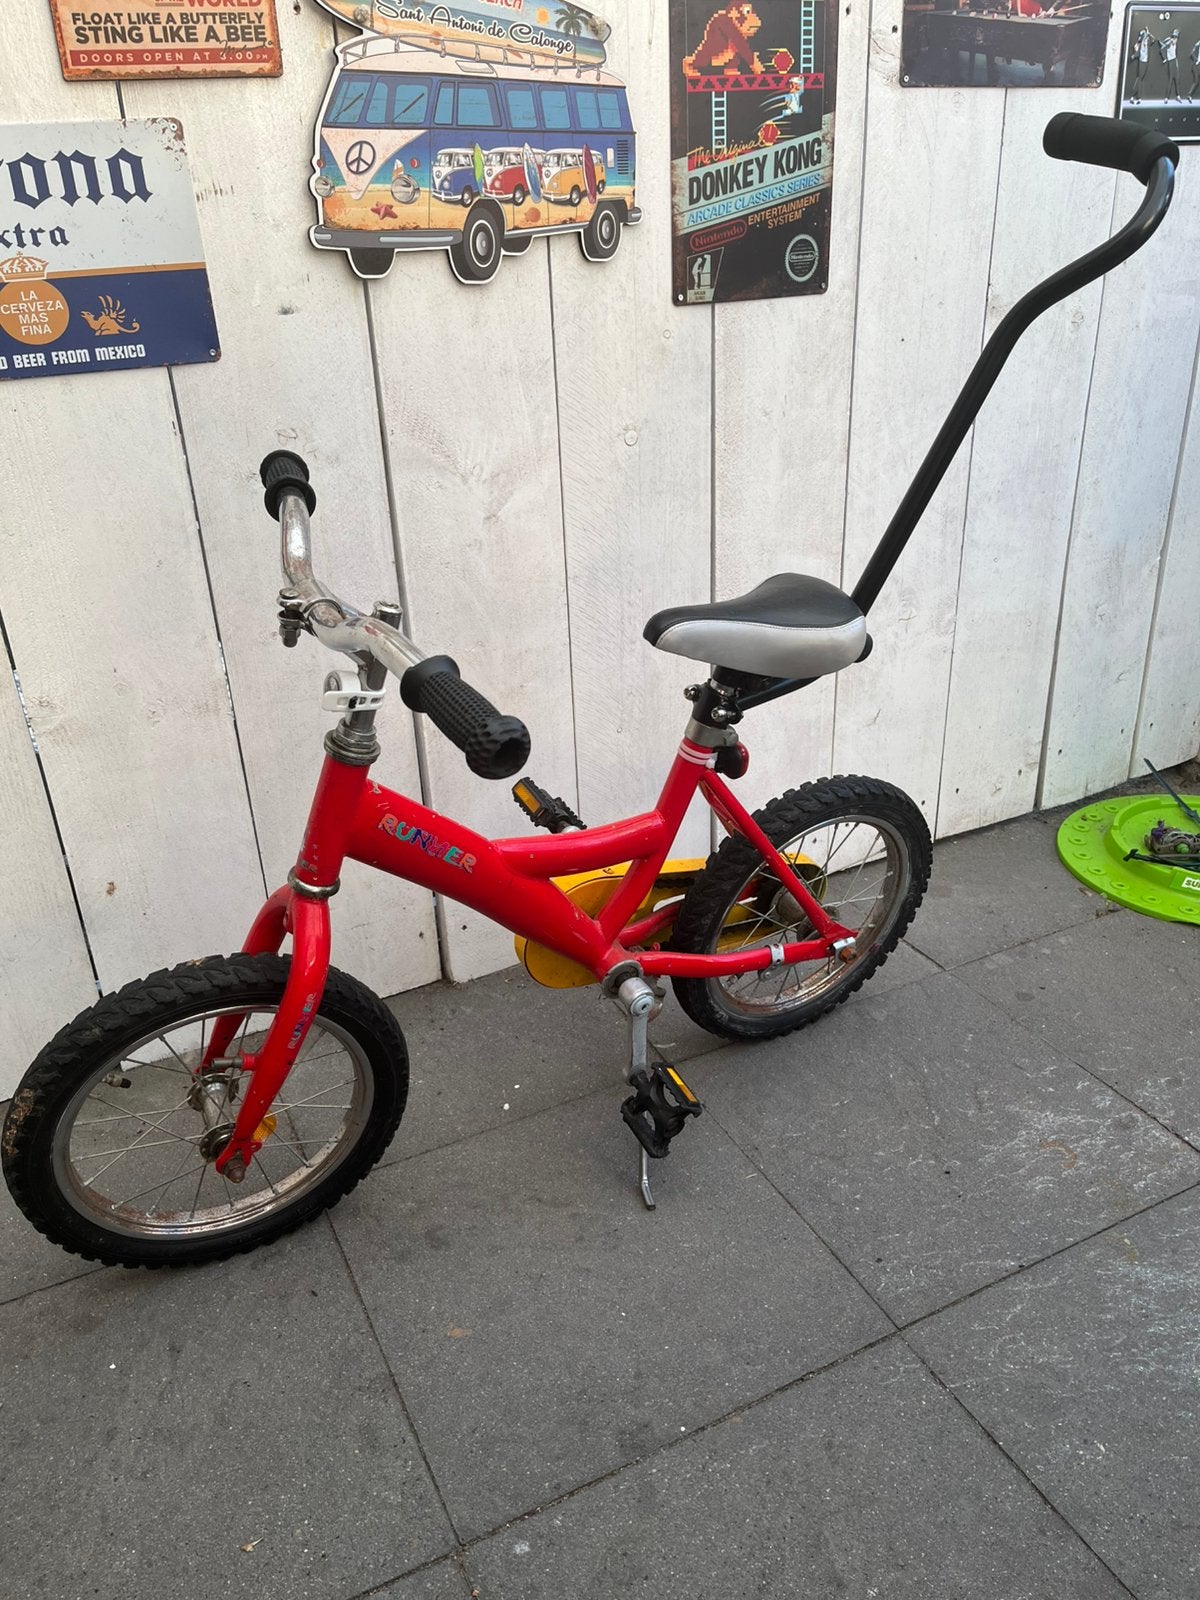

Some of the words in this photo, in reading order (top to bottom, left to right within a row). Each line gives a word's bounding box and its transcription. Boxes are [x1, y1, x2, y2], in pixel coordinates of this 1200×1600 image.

[72, 12, 123, 25] FLOAT
[127, 13, 161, 24] LIKE
[165, 12, 177, 25] A
[180, 12, 264, 24] BUTTERFLY
[376, 0, 423, 20] Sant
[428, 6, 485, 33] Antoni
[488, 22, 505, 38] de
[510, 24, 574, 54] Calonge
[75, 26, 144, 44] STING
[149, 25, 199, 43] LIKE
[204, 25, 221, 42] A
[225, 25, 267, 42] BEE
[79, 53, 134, 63] DOORS
[143, 52, 184, 62] OPEN
[193, 52, 211, 61] AT
[0, 147, 153, 210] ona
[688, 154, 768, 206] DONKEY
[773, 137, 822, 179] KONG
[687, 202, 732, 225] ARCADE
[734, 185, 786, 210] CLASSICS
[787, 173, 821, 194] SERIES
[748, 193, 821, 225] ENTERTAINMENT
[768, 210, 802, 229] SYSTEM
[694, 225, 744, 247] Nintendo
[21, 290, 38, 301] LA
[0, 300, 64, 315] CERVEZA
[18, 312, 49, 325] MAS
[21, 324, 53, 336] FINA
[13, 353, 46, 369] BEER
[51, 348, 90, 365] FROM
[95, 344, 146, 361] MEXICO
